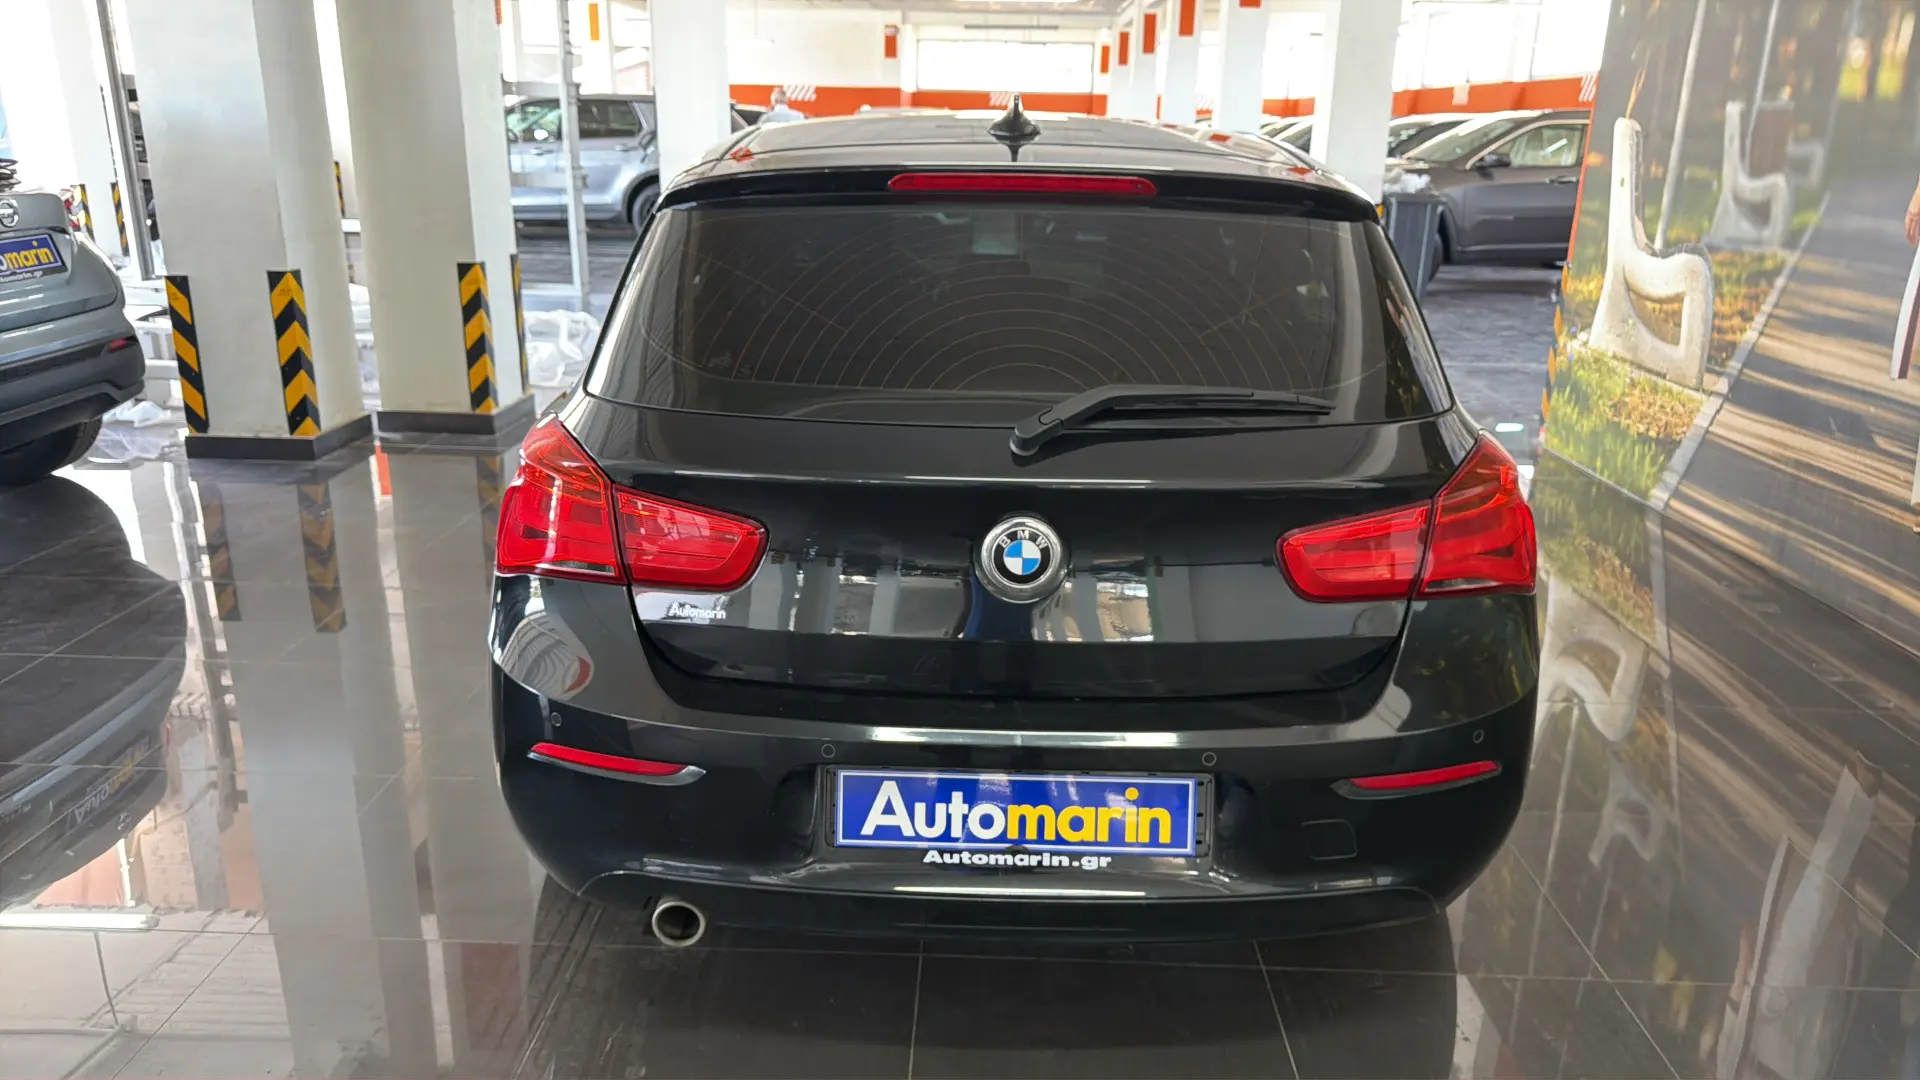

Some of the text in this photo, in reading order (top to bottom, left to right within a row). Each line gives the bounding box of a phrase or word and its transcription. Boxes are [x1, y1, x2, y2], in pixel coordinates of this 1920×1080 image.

[998, 530, 1049, 549] BMW
[668, 602, 726, 619] Automarin
[860, 780, 1171, 843] Automarin
[923, 850, 1112, 870] Automarin.gr
